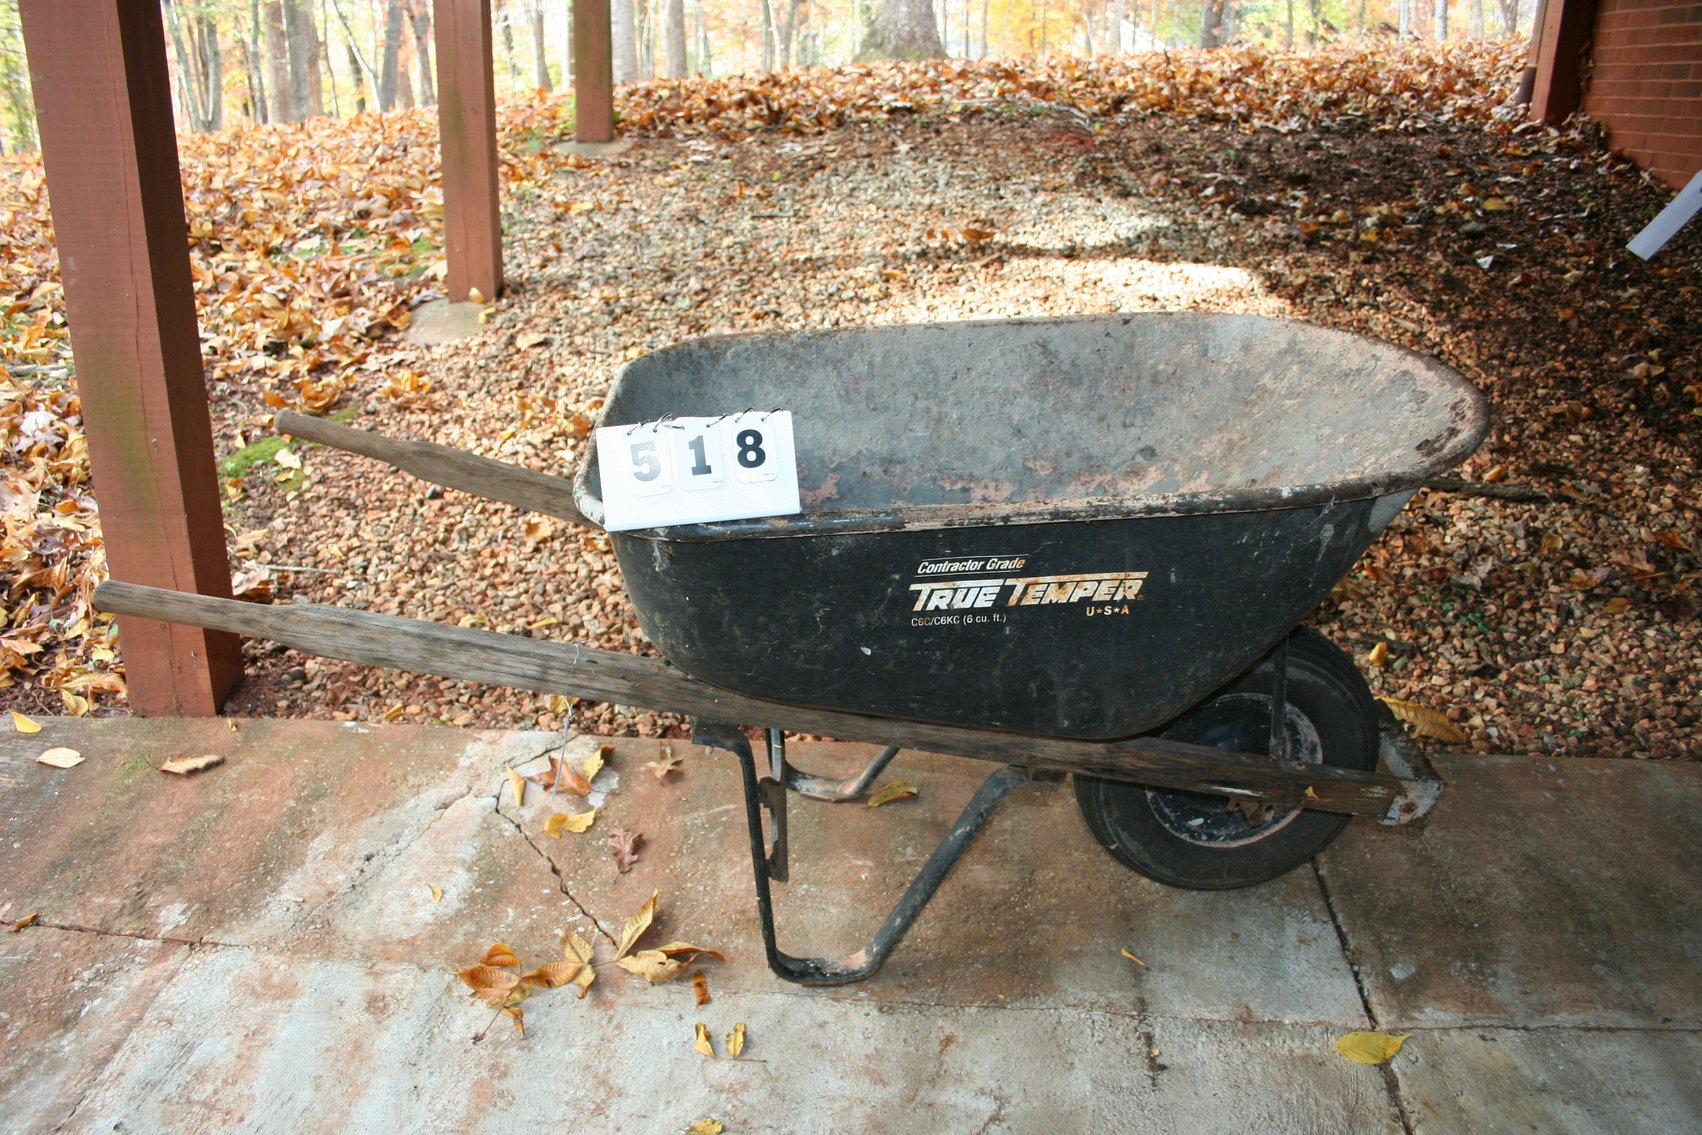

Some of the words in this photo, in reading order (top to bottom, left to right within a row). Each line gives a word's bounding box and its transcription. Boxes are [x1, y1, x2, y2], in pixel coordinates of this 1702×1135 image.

[917, 559, 985, 575] Contractor
[986, 557, 1026, 571] Grade
[909, 579, 1004, 612] TRUE
[1005, 571, 1149, 607] TEMPER
[911, 615, 960, 627] C6C/C6KC
[963, 614, 973, 625] (6
[975, 615, 990, 624] cu.
[993, 613, 1007, 624] ft.)
